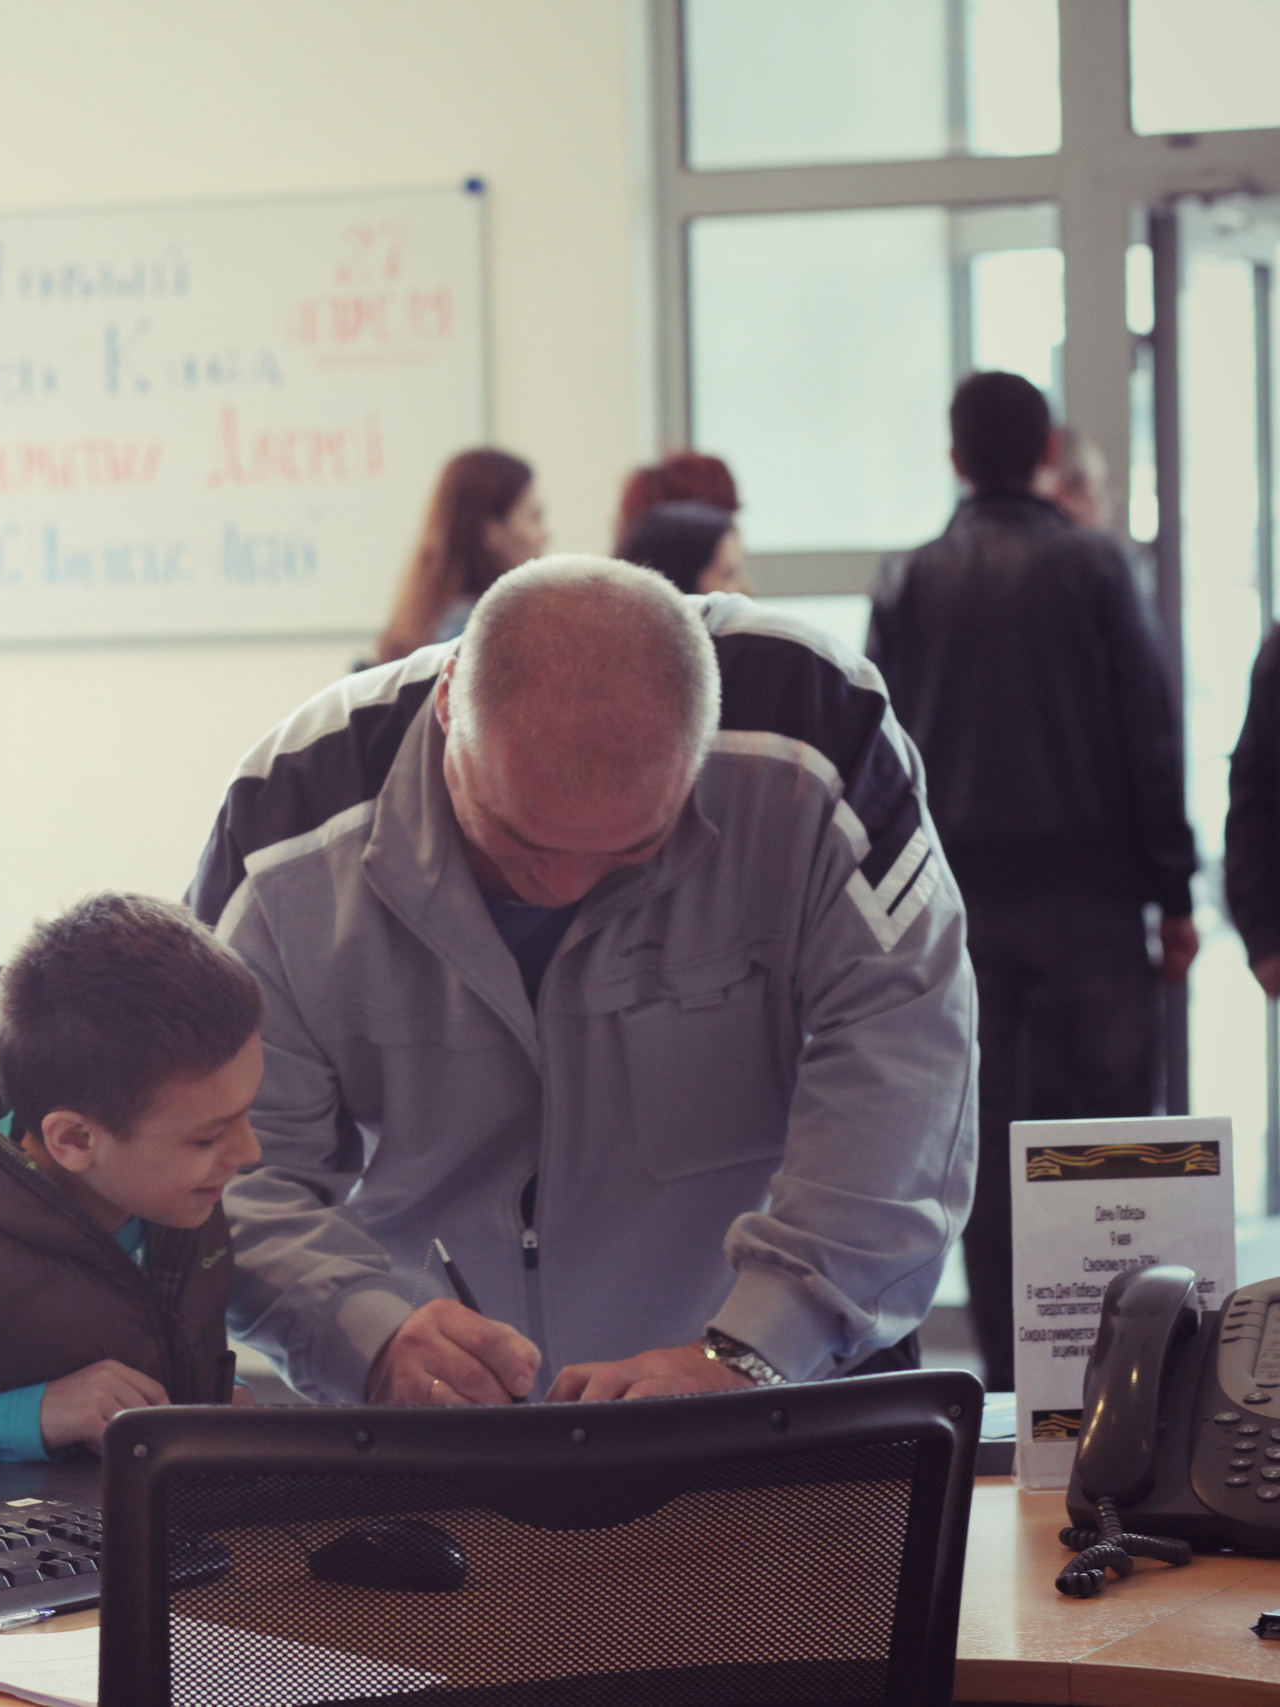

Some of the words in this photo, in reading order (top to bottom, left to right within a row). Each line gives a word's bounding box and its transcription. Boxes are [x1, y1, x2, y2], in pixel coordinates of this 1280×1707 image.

[1095, 1206, 1114, 1223] День
[1116, 1204, 1145, 1222] Победы
[1110, 1230, 1115, 1246] 9
[1117, 1233, 1131, 1246] мая
